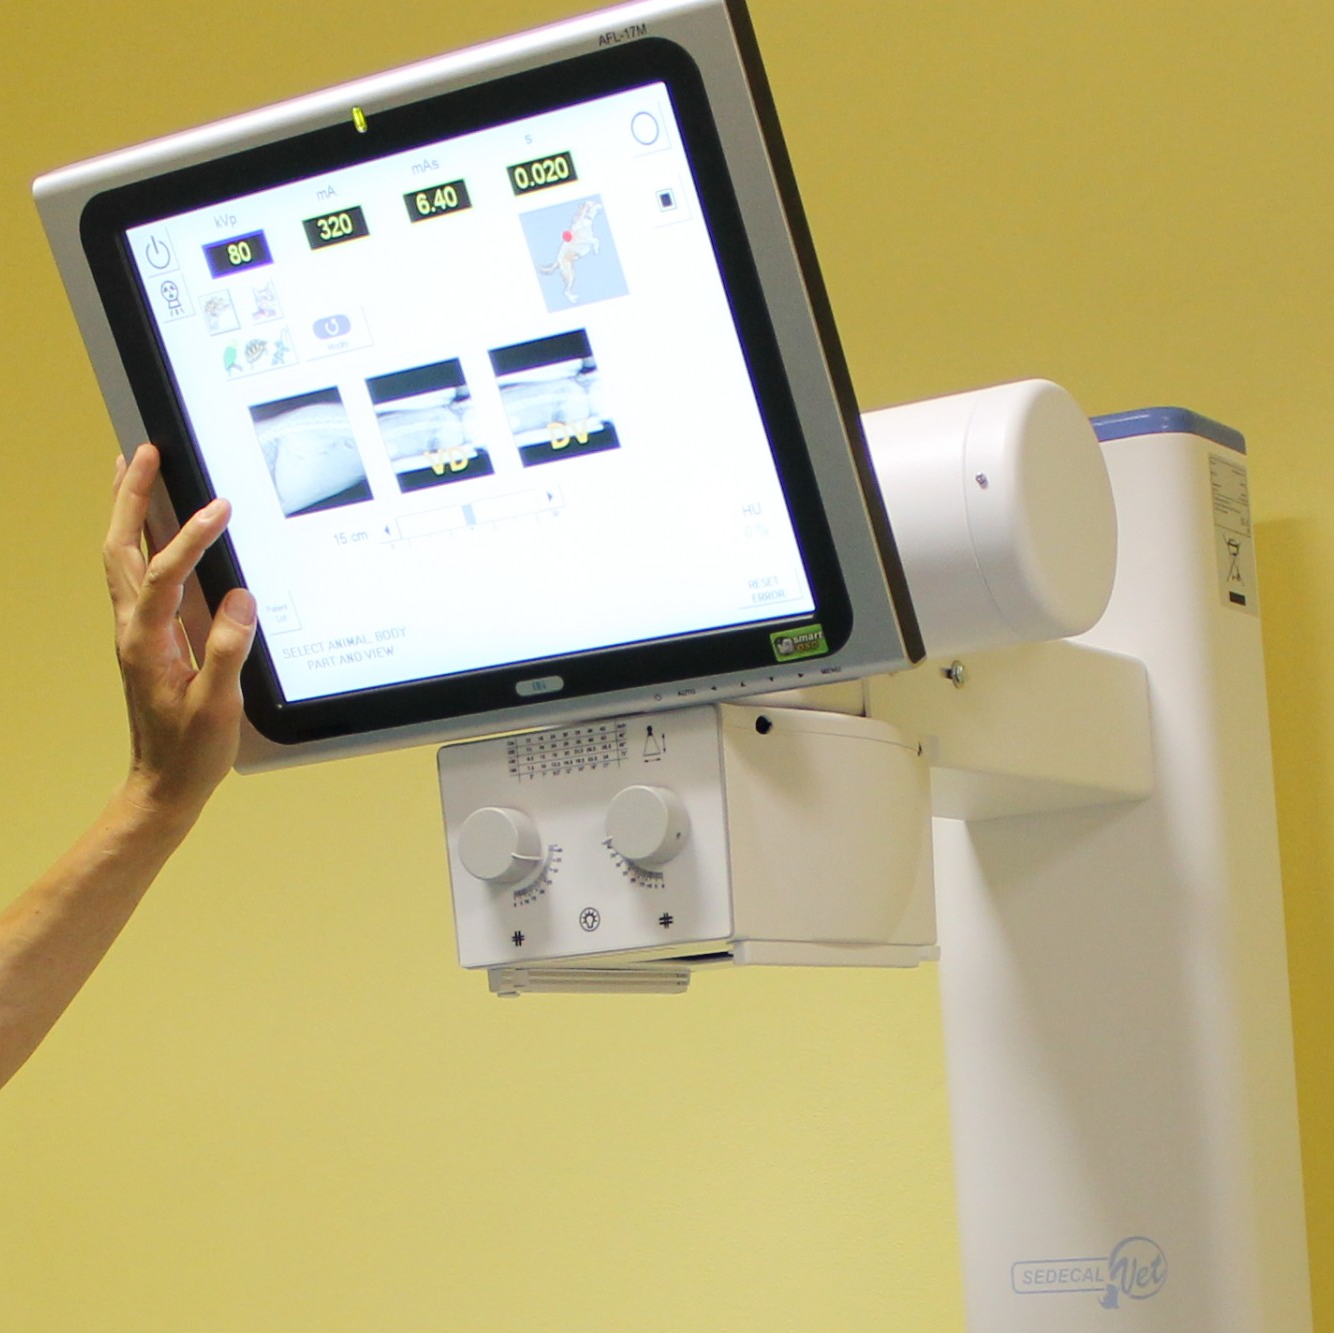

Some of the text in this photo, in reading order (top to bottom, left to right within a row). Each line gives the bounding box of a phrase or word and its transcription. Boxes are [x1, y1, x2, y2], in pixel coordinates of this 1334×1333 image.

[598, 23, 647, 46] AFL-17M
[411, 158, 439, 175] mAs
[514, 156, 569, 190] 0.020
[316, 185, 337, 201] mA
[416, 186, 458, 215] 6.40
[214, 213, 237, 228] kVp
[317, 213, 353, 240] 320
[227, 241, 252, 265] 80
[547, 420, 589, 450] DV
[424, 447, 469, 476] VD
[741, 502, 762, 517] HU
[333, 528, 369, 546] 15 cm
[282, 626, 407, 660] SELECT ANIMAL BODY
[307, 645, 395, 671] PART AND VIEW
[1022, 1254, 1165, 1294] SEDECAL Vet
